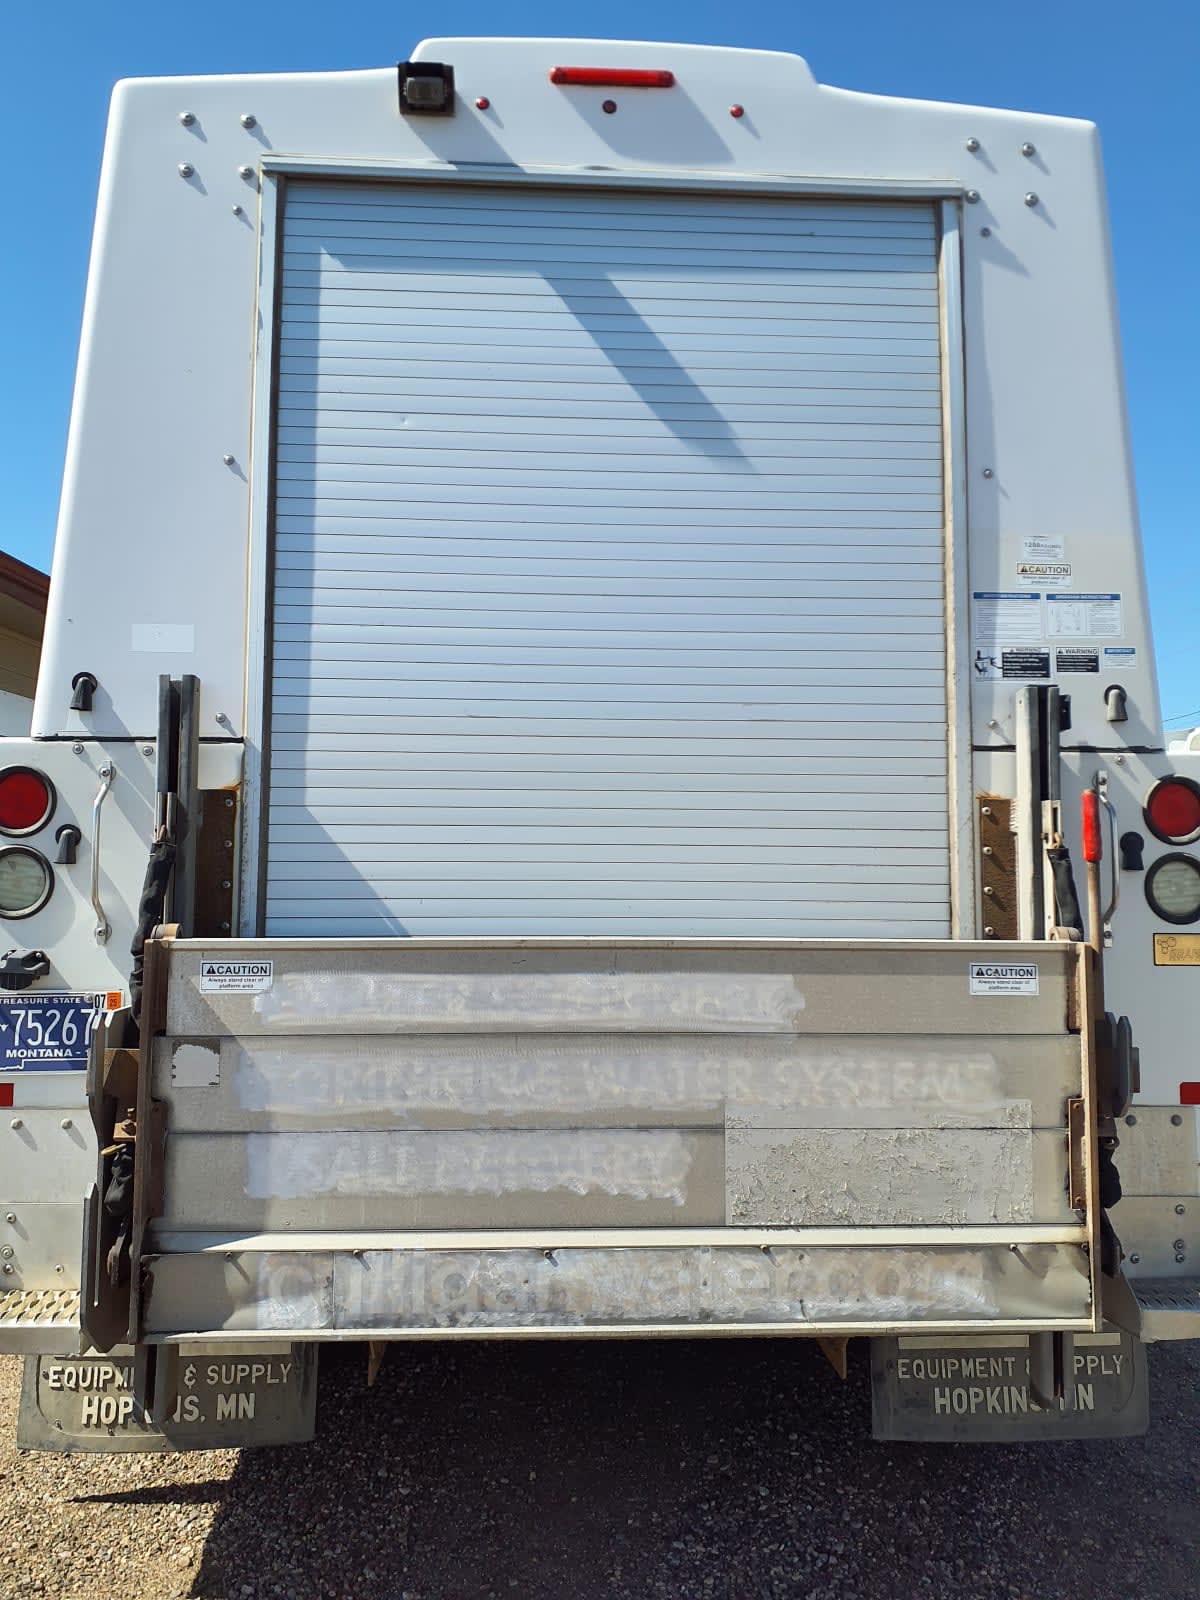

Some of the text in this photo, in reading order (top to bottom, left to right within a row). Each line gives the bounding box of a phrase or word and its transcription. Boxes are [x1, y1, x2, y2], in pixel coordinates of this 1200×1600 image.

[1029, 566, 1069, 574] CAUTION
[217, 965, 268, 975] CAUTION
[985, 967, 1033, 977] CAUTION
[94, 994, 106, 1009] 07
[6, 1048, 73, 1058] MONTANA
[897, 1357, 1016, 1379] EQUIPMENT
[1073, 1354, 1123, 1376] PPLY
[183, 1363, 197, 1390] &
[206, 1363, 292, 1385] SUPPLY
[216, 1392, 255, 1421] MN
